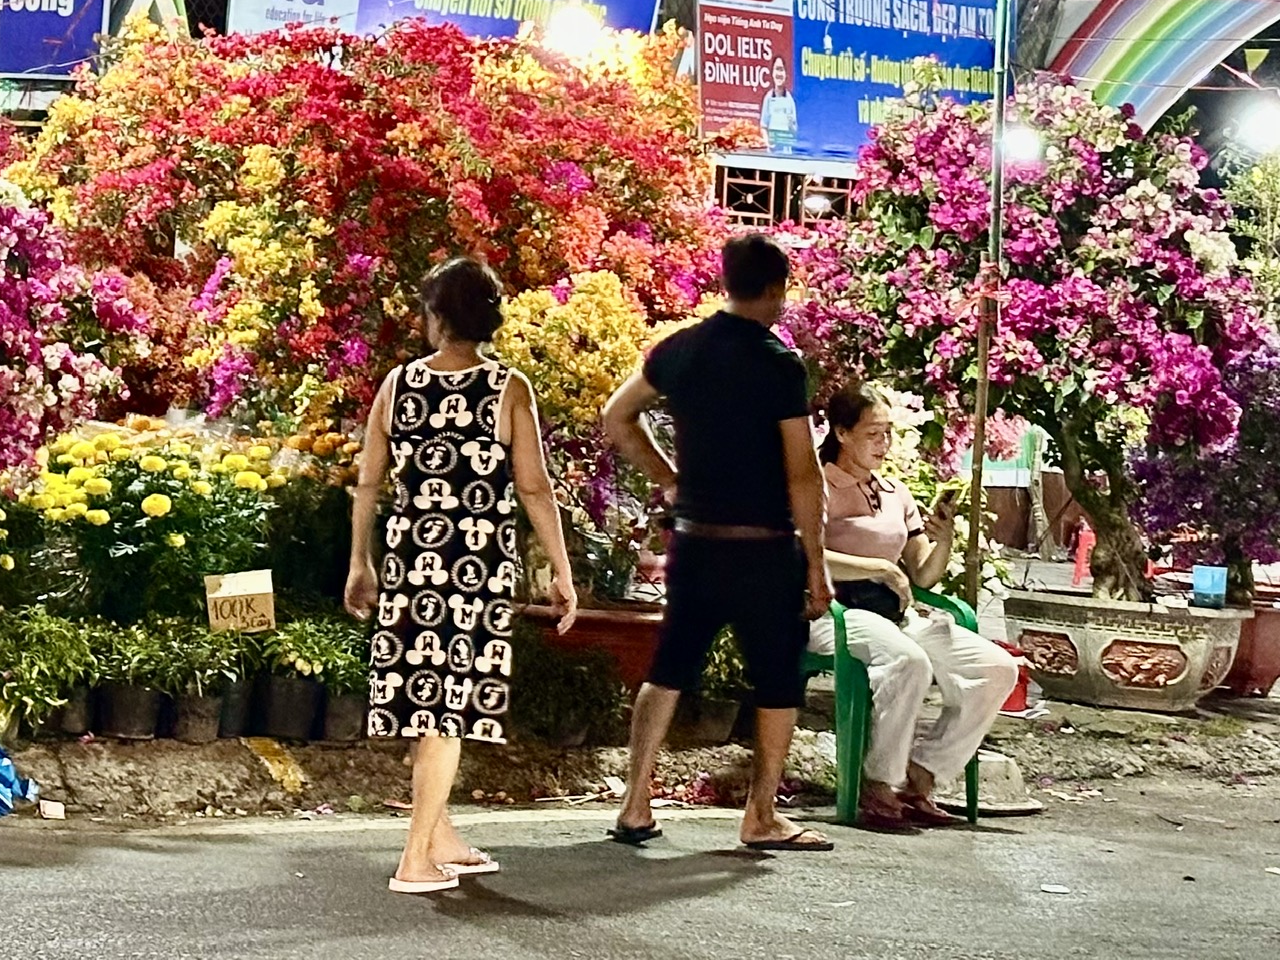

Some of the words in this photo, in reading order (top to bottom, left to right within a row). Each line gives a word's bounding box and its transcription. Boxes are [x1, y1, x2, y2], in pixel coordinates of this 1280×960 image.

[704, 31, 735, 57] DOL
[737, 36, 773, 61] IELTS
[704, 56, 740, 86] ĐÌNH
[742, 65, 770, 92] LỰC
[211, 597, 257, 620] 100K
